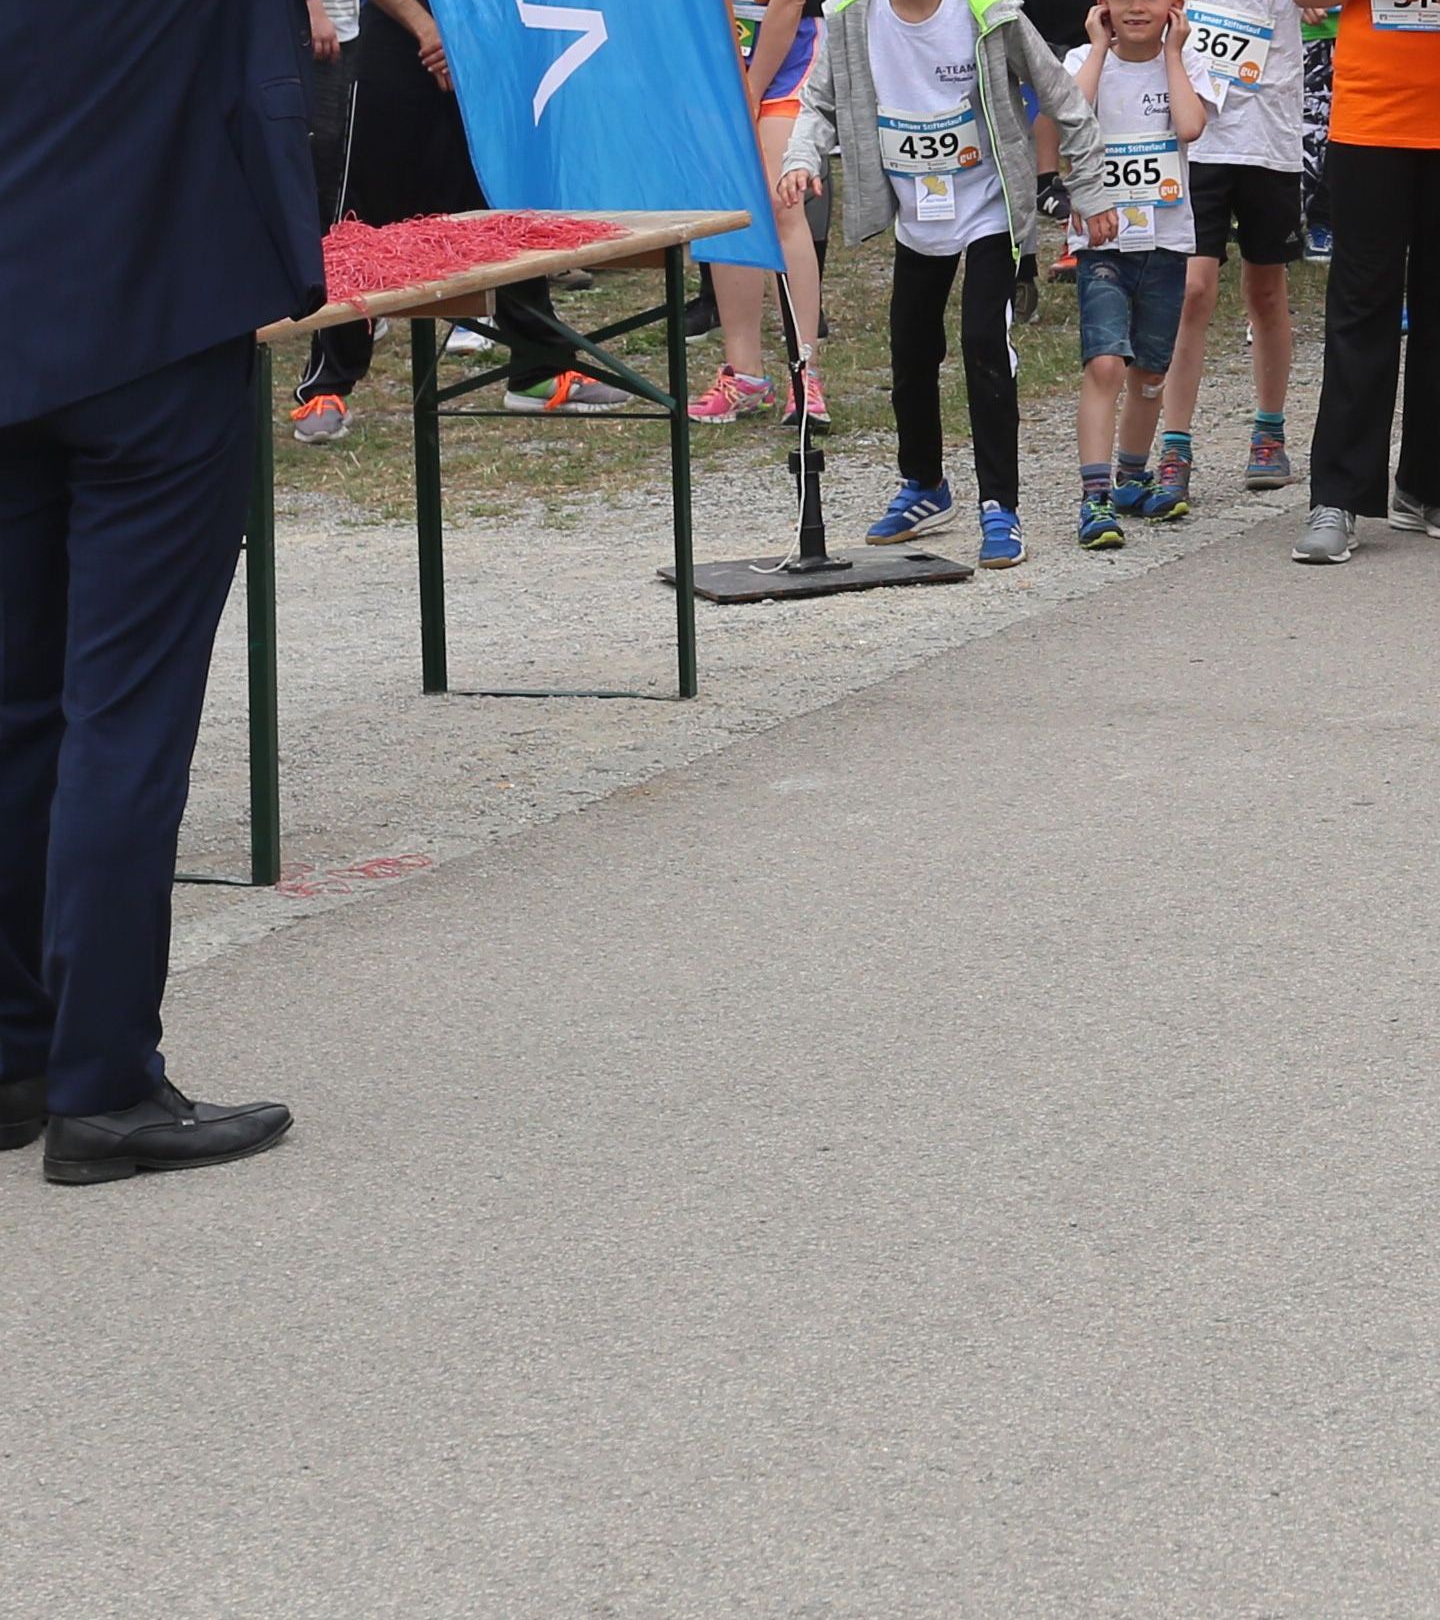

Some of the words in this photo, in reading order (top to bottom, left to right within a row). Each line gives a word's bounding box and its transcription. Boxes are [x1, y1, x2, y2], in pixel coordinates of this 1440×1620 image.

[1224, 18, 1261, 35] Stifterlauf
[1193, 27, 1250, 61] 367
[935, 62, 977, 75] A-TEAM
[1240, 66, 1259, 80] gut
[898, 121, 921, 130] Jenaer
[922, 115, 962, 131] Stifterlauf
[899, 132, 959, 160] 439
[1105, 146, 1126, 154] enaer
[1127, 142, 1167, 154] Stifterlauf
[959, 151, 978, 164] gut
[1103, 158, 1161, 188] 365
[1160, 184, 1177, 197] gut
